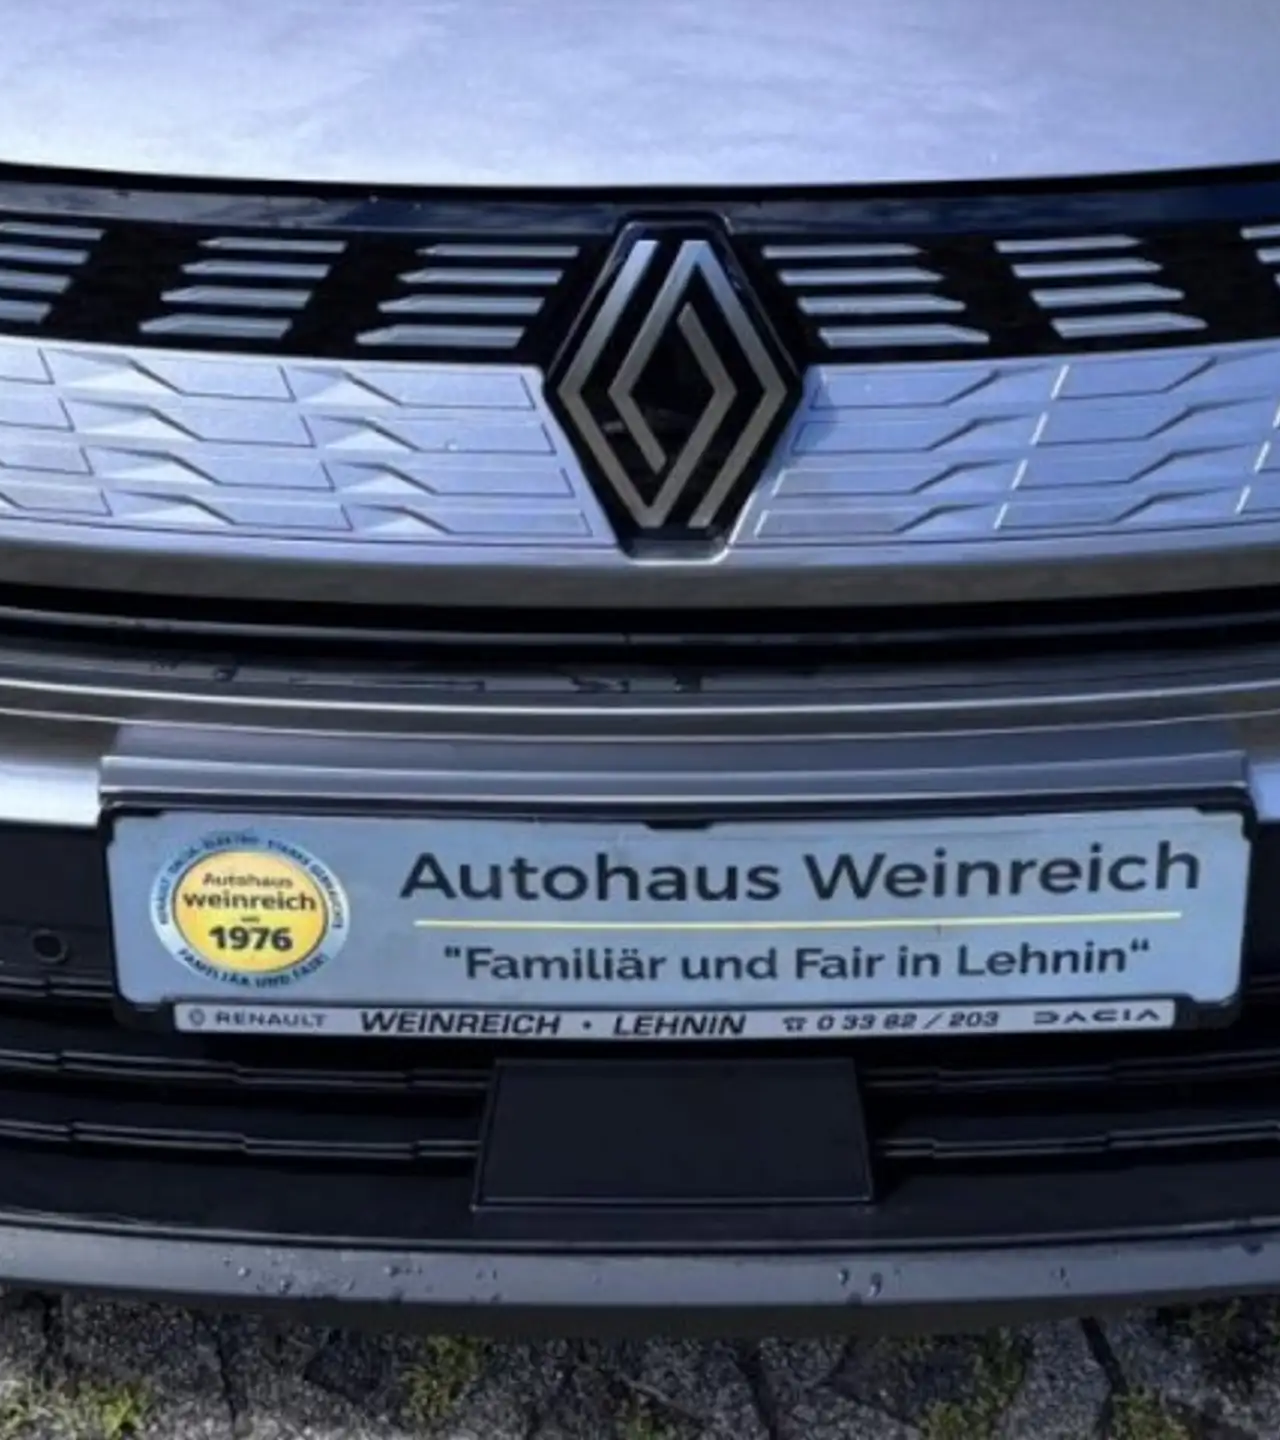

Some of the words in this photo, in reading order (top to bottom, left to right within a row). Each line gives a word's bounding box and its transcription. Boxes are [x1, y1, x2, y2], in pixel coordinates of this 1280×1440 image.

[203, 873, 293, 888] Autohaus
[400, 852, 781, 901] Autohaus
[802, 840, 1200, 900] Weinreich
[184, 890, 317, 910] weinreich
[209, 926, 293, 951] 1976
[681, 947, 778, 981] und
[795, 946, 884, 980] Fair
[897, 944, 941, 978] in
[215, 1010, 328, 1028] RENAULT
[360, 1010, 563, 1036] WEINREICH
[613, 1013, 747, 1036] LEHNIN
[1033, 1008, 1161, 1026] DACIA
